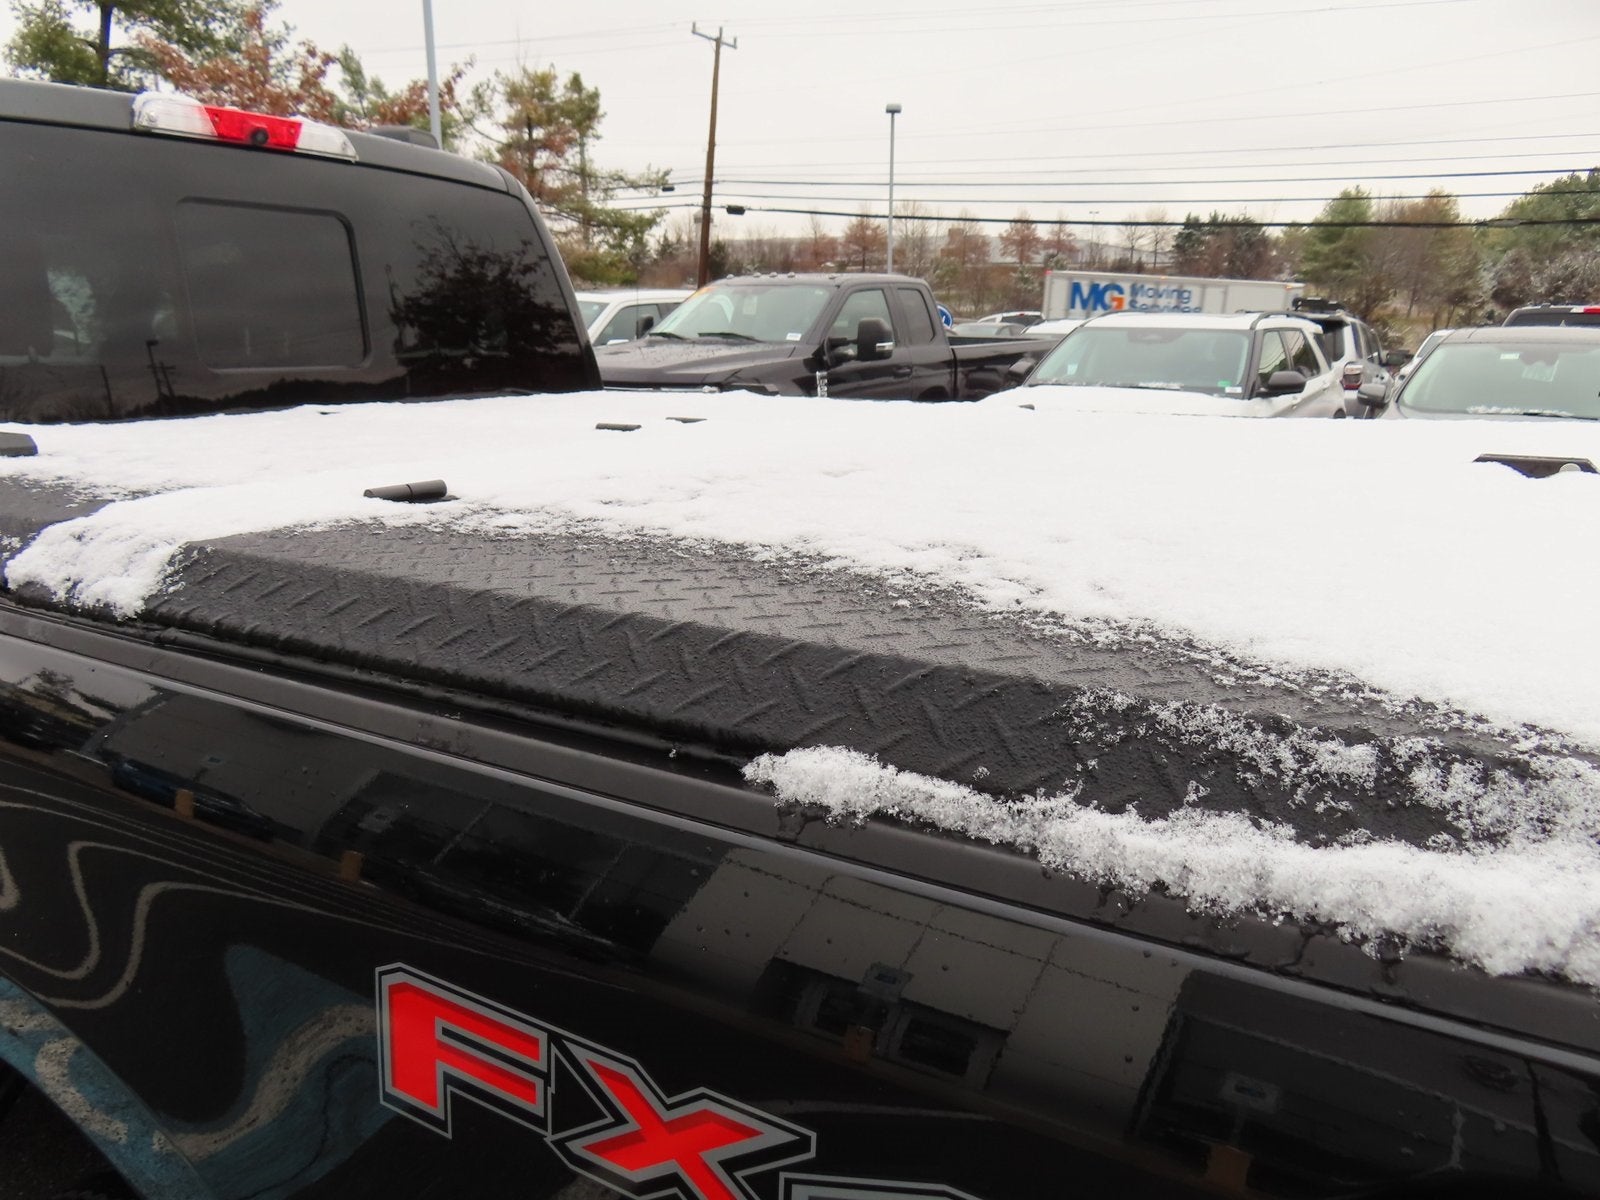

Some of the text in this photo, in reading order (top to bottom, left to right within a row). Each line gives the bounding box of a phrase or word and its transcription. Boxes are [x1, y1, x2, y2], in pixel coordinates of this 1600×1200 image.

[1070, 282, 1125, 311] MG
[1129, 282, 1192, 304] Moving
[375, 962, 985, 1200] FX
